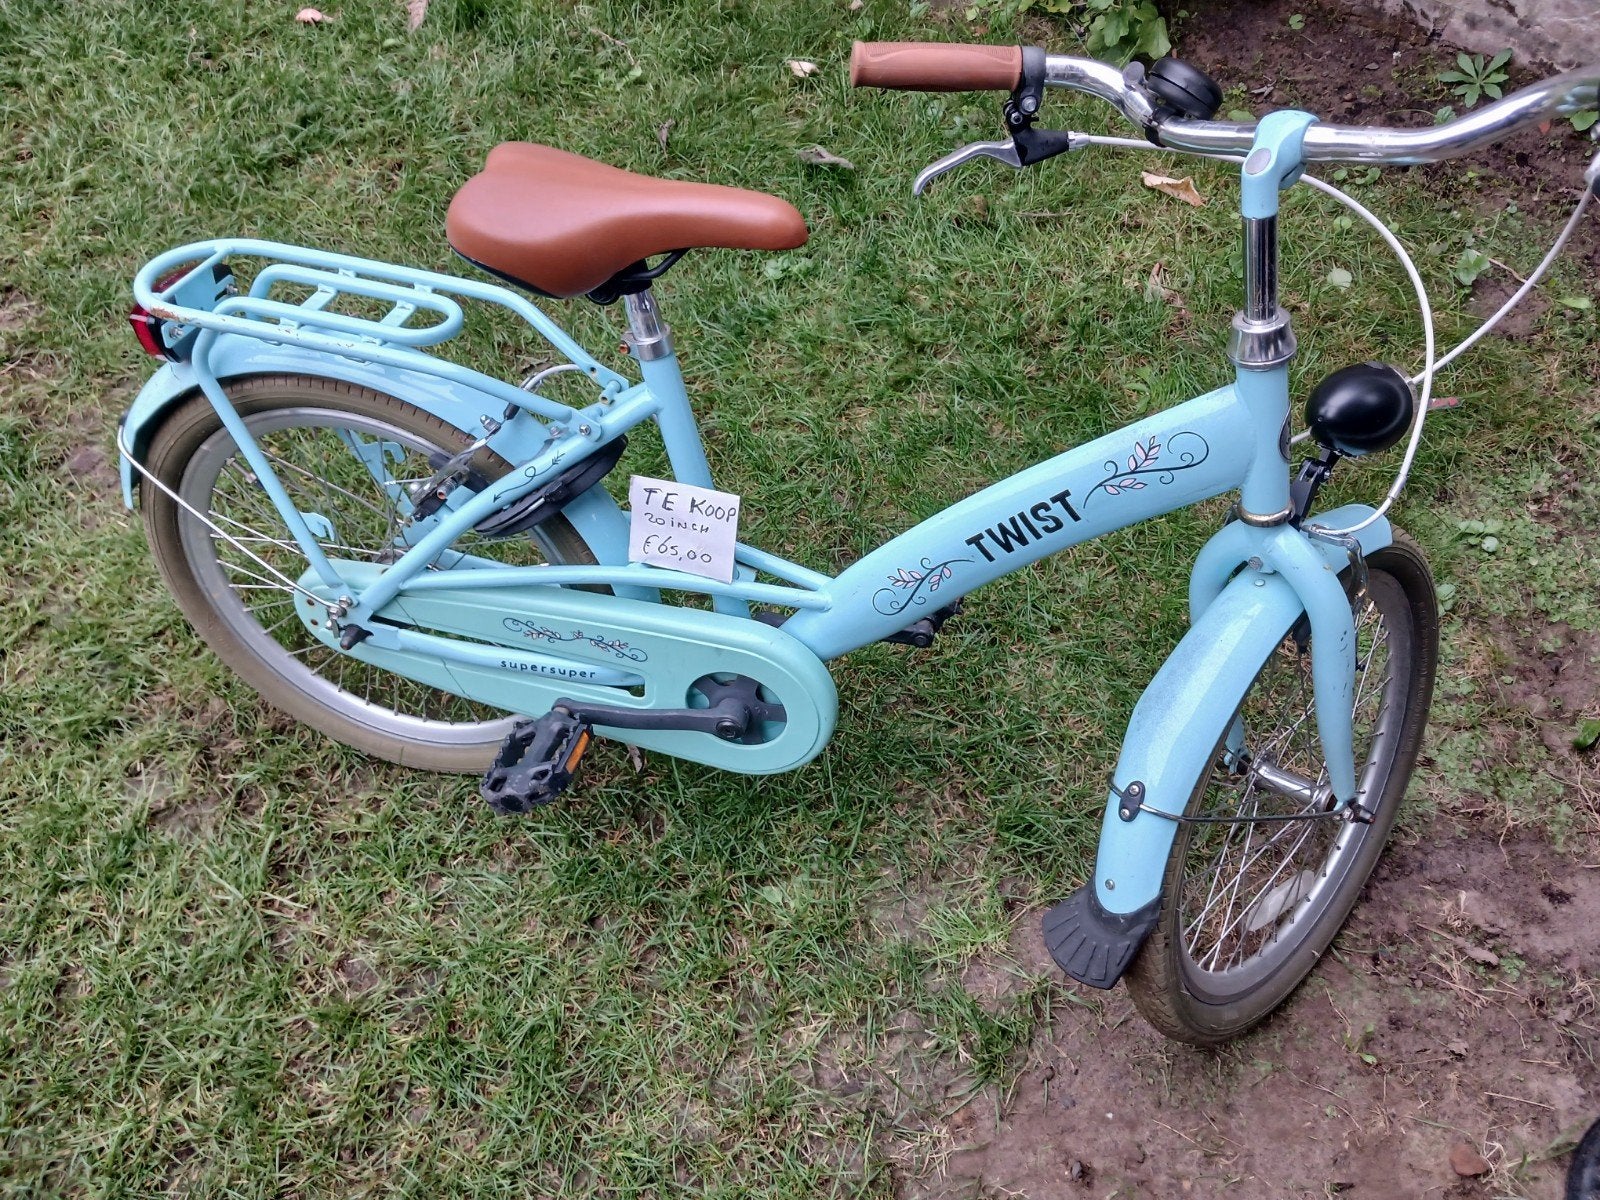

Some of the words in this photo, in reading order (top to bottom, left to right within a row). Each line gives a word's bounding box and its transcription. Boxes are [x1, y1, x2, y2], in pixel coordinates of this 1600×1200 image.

[643, 487, 678, 511] TE
[689, 497, 737, 522] KOOP
[965, 489, 1082, 563] TWIST
[643, 534, 712, 563] €65,00
[501, 660, 596, 679] supersuper
